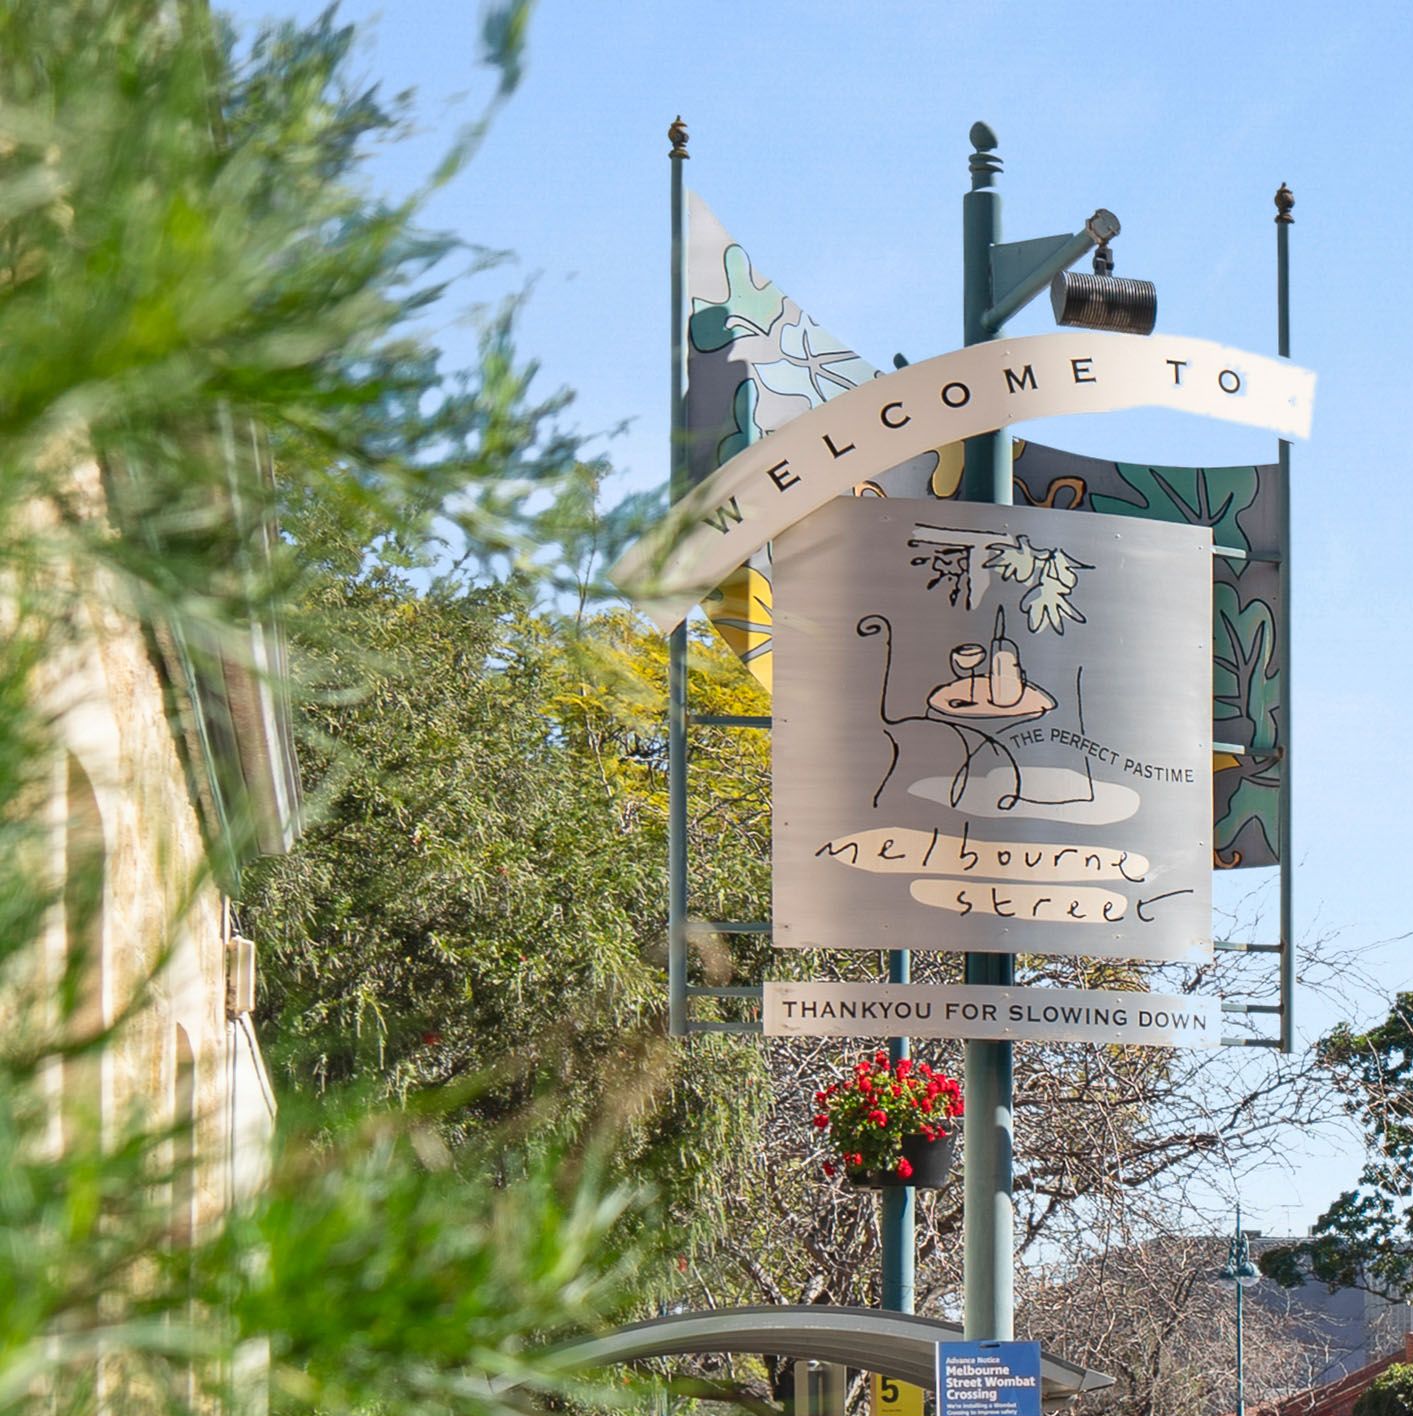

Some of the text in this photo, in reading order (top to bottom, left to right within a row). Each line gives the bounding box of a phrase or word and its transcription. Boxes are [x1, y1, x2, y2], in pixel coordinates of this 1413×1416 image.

[702, 357, 1242, 535] WELCOME TO
[1010, 728, 1195, 784] THE PERFECT PASTIME
[956, 887, 1195, 922] street
[783, 1000, 1207, 1031] THANKYOU FOR SLOWING DOWN
[945, 1356, 1000, 1364] Advance Notice
[945, 1365, 1010, 1376] Melbourne
[881, 1375, 899, 1403] 5
[945, 1375, 1036, 1388] Street Wombat
[946, 1389, 997, 1402] Crossing
